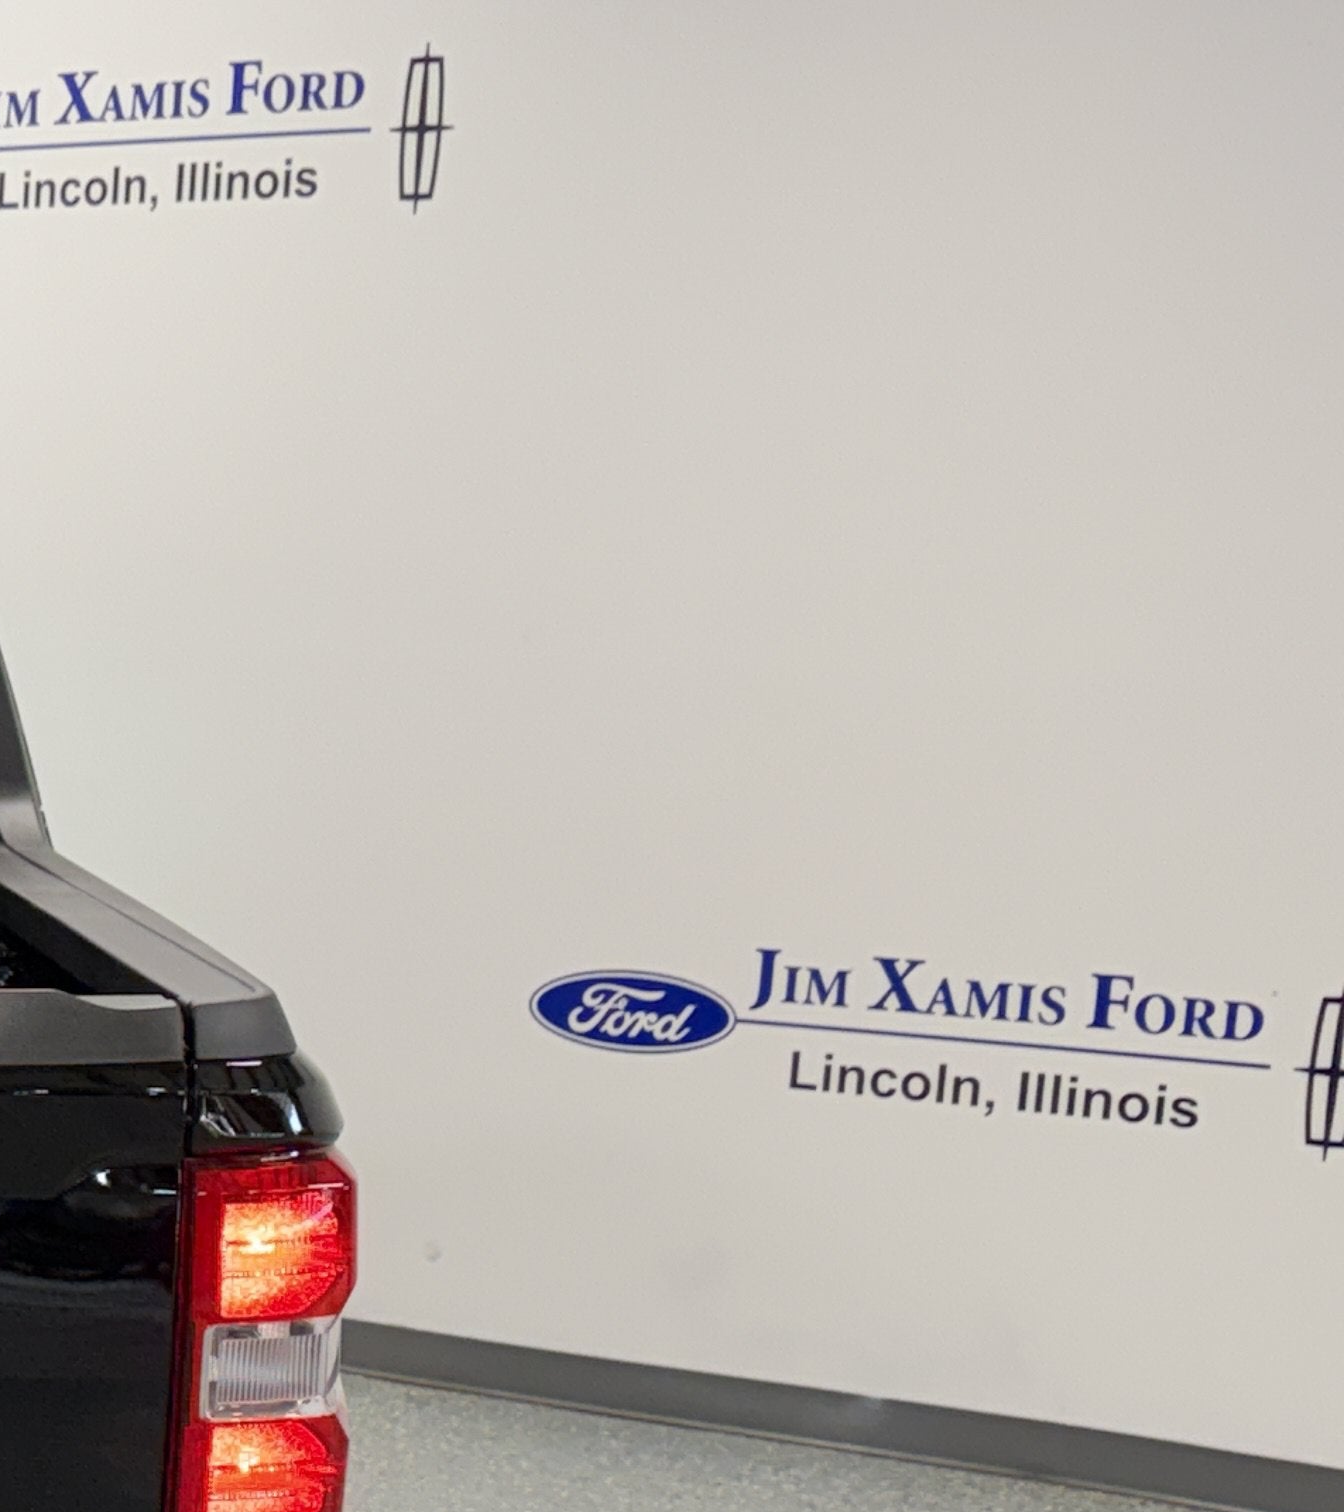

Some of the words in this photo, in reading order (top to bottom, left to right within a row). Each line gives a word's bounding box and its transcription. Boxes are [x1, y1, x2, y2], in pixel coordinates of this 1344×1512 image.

[54, 71, 210, 125] XAMIS
[227, 60, 366, 116] FORD
[175, 158, 318, 202] Illinois
[567, 982, 692, 1043] Ford
[749, 948, 850, 1011] JIM
[867, 957, 1066, 1026] XAMIS
[1086, 973, 1265, 1042] FORD
[788, 1050, 995, 1117] Lincoln,
[1017, 1072, 1199, 1129] Illinois
